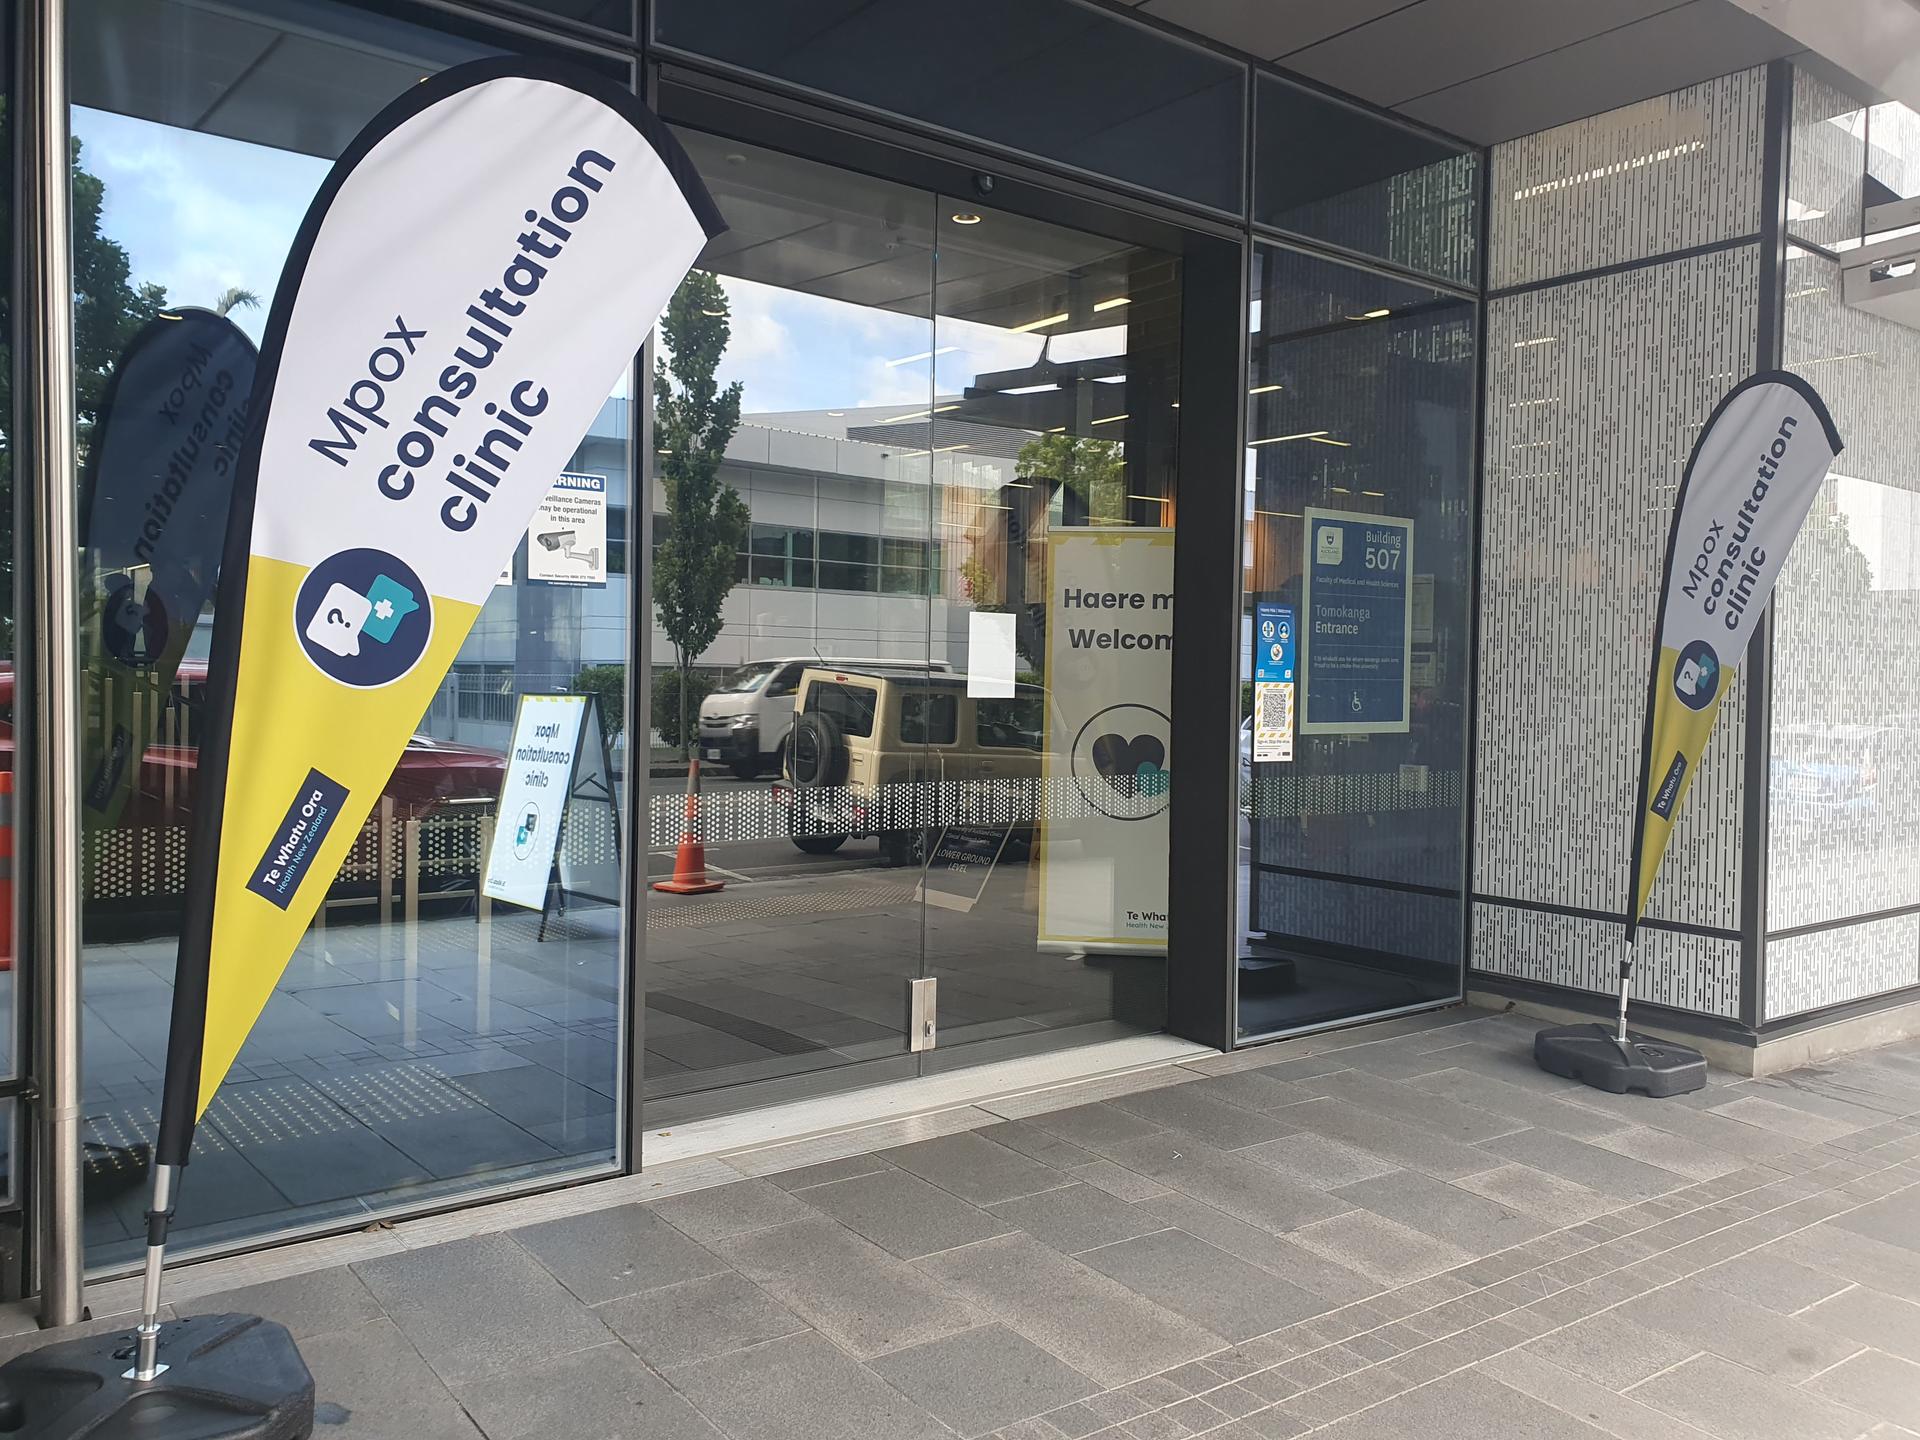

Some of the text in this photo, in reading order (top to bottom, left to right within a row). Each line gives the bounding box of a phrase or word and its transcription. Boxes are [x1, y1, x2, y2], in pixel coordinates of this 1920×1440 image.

[377, 149, 616, 501] consultation
[309, 316, 427, 467] Mpox
[440, 379, 549, 532] clinic
[562, 507, 598, 515] operational
[574, 497, 601, 506] Cameras
[1704, 416, 1798, 615] consultation
[1366, 531, 1401, 548] Building
[1365, 547, 1400, 570] 507
[1682, 519, 1724, 599] Mpox
[1064, 588, 1145, 609] Haere
[1725, 546, 1766, 630] clinic
[1315, 604, 1370, 622] Tomokanga
[1315, 621, 1358, 634] Entrance
[1657, 800, 1667, 809] Te
[1662, 777, 1677, 800] Whatu
[263, 789, 323, 885] Te Whatu Ora
[276, 806, 328, 893] Health New Zealand
[937, 849, 991, 865] LOWER GROUND
[948, 862, 968, 873] LEVEL
[1127, 911, 1138, 920] Te
